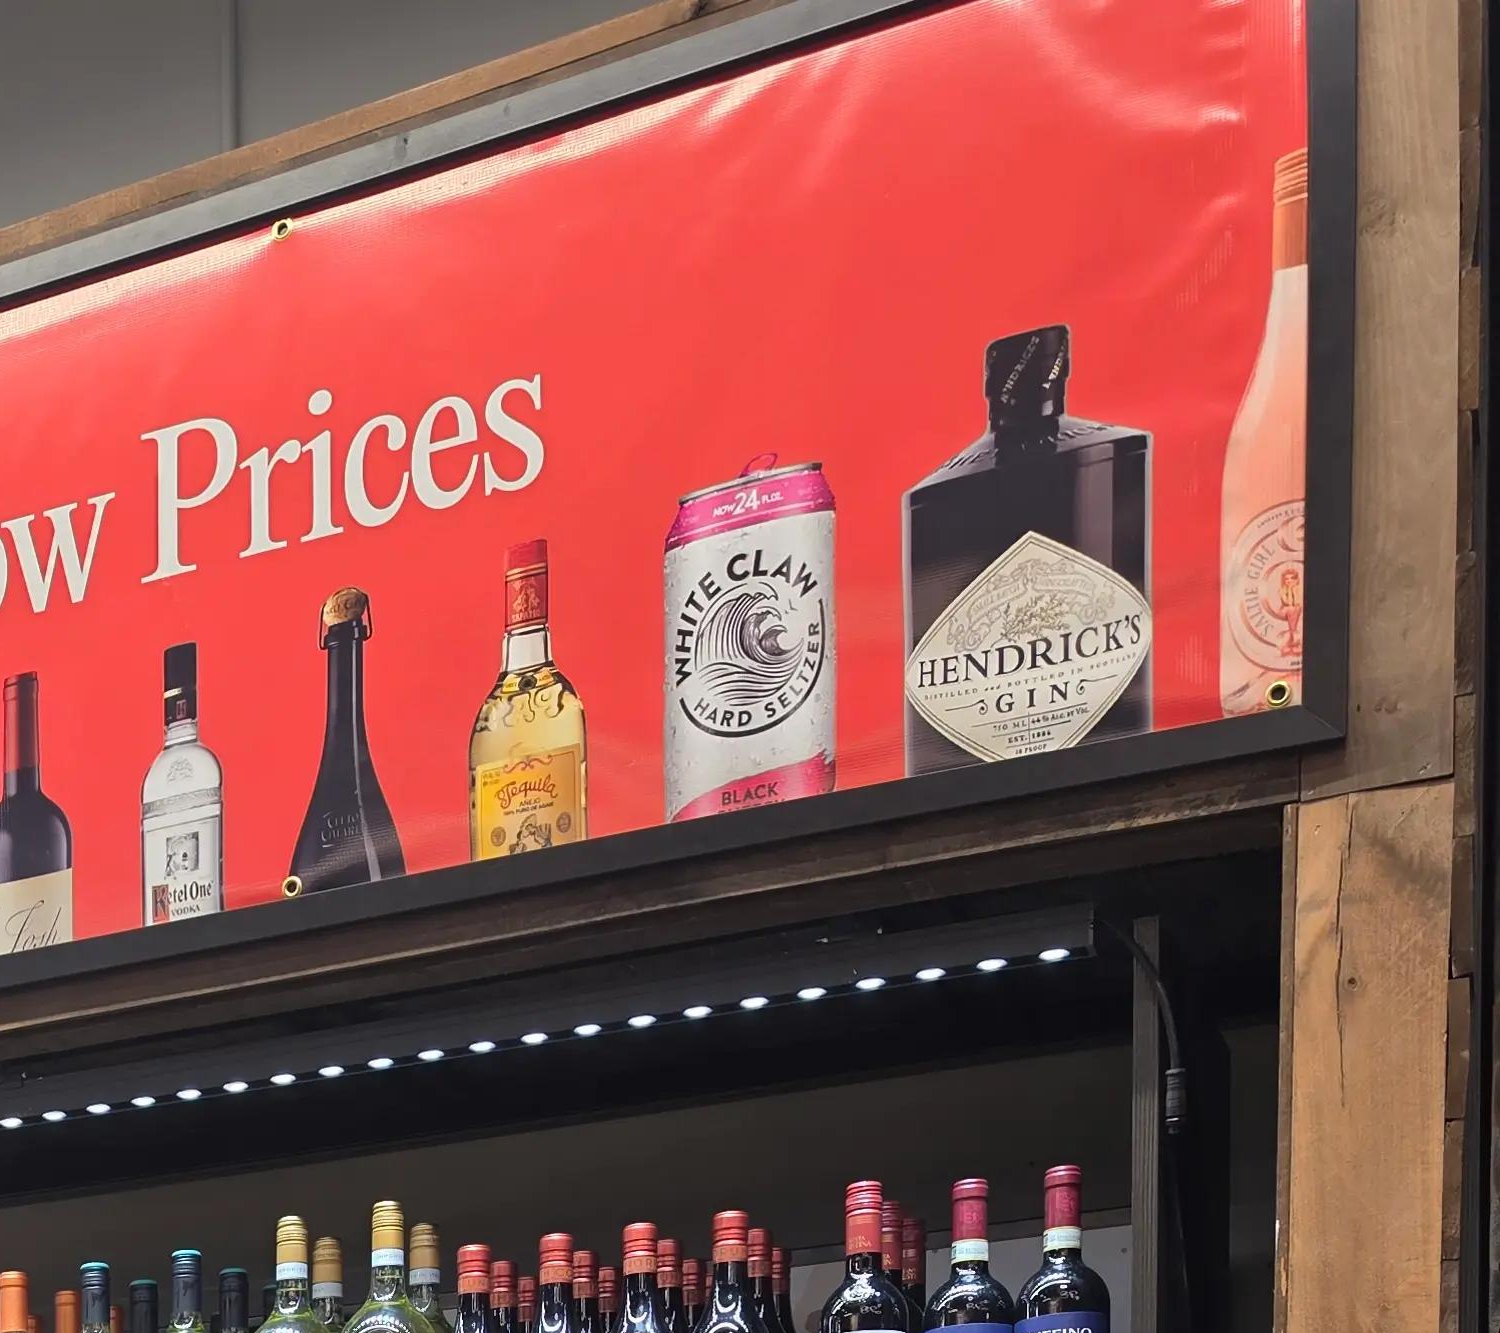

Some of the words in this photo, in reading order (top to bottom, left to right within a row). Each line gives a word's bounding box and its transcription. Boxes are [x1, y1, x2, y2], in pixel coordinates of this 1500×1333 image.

[141, 373, 545, 585] Prices
[712, 503, 736, 517] NOW
[733, 489, 761, 515] 24
[675, 572, 722, 687] WHITE
[726, 550, 818, 597] CLAW
[918, 614, 1141, 688] HENDRICK'S
[694, 697, 752, 727] HARD
[764, 622, 820, 720] SELTZER
[995, 681, 1070, 713] GIN
[496, 775, 557, 809] Tequila
[722, 782, 779, 806] BLACK
[153, 880, 188, 921] Ketel
[190, 880, 212, 908] One
